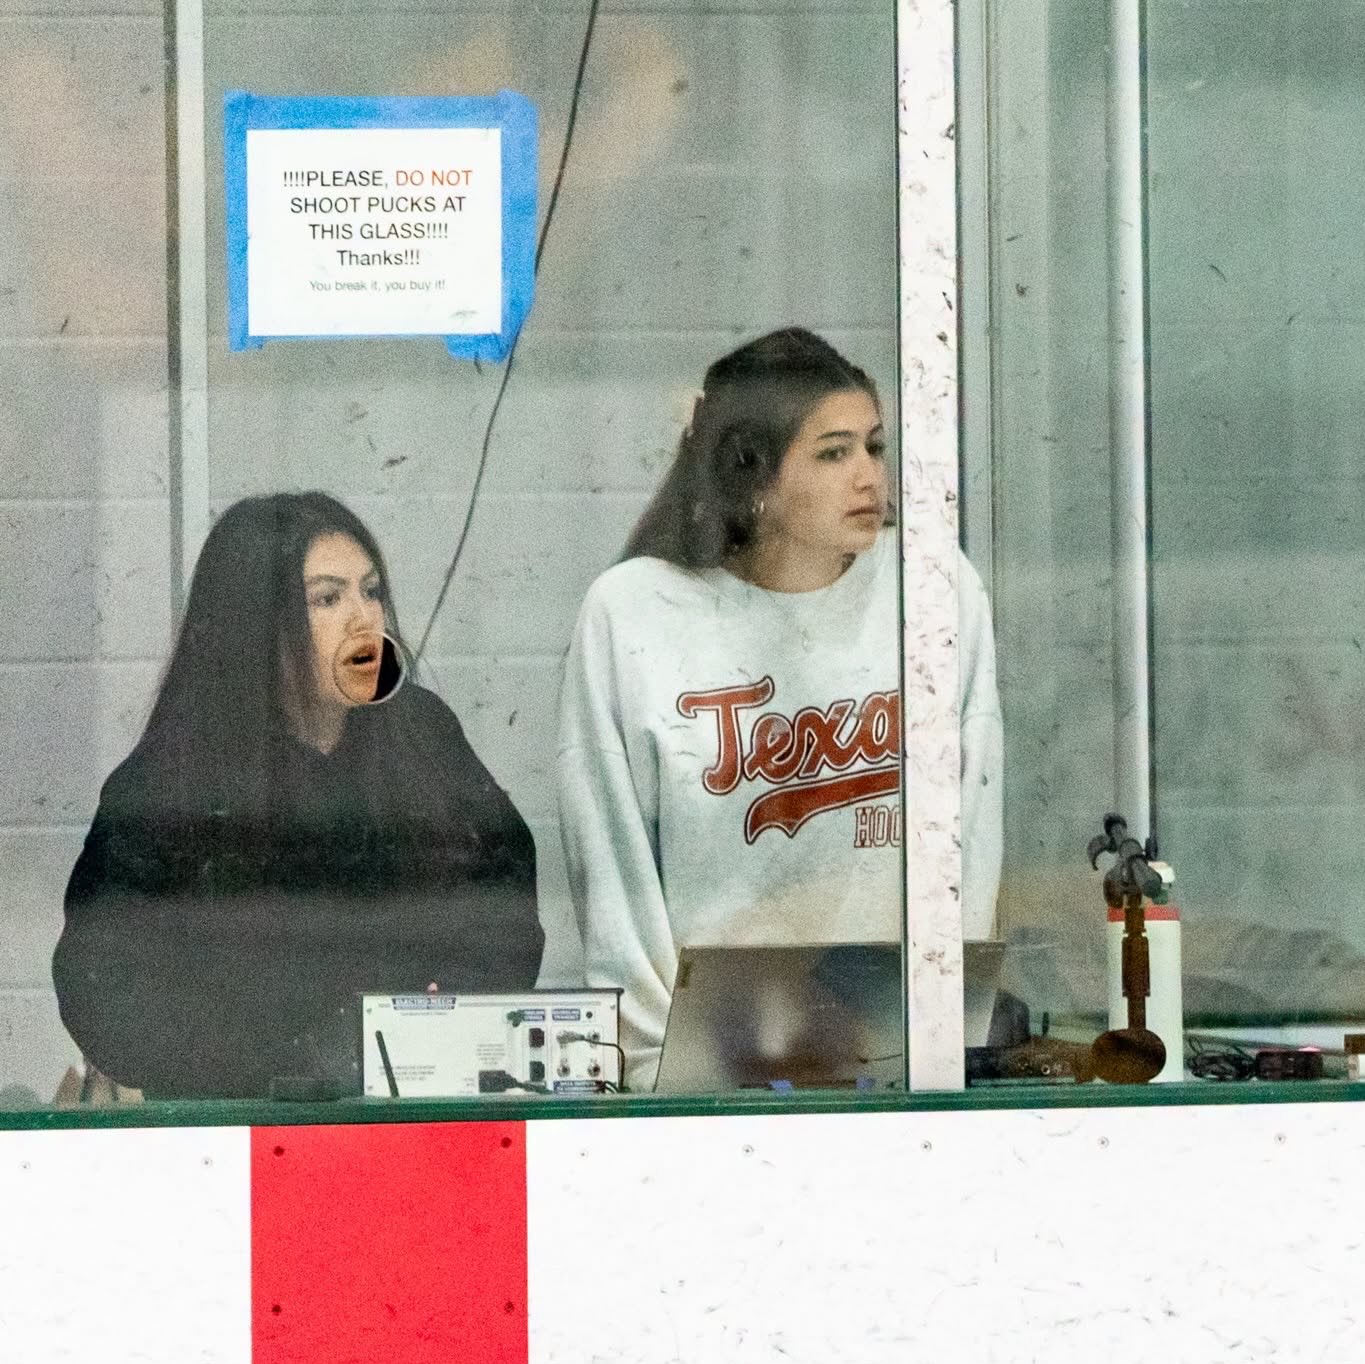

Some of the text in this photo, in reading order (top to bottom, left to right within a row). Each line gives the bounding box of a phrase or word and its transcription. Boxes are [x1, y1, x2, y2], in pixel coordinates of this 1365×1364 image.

[283, 170, 473, 188] !!!!PLEASE, DO NOT
[290, 196, 467, 213] SHOOT PUCKS AT
[308, 222, 448, 239] THIS GLASS!!!!
[336, 249, 420, 266] Thanks!!!
[309, 280, 331, 291] You
[335, 280, 368, 291] break
[384, 281, 406, 292] you
[409, 280, 431, 291] buy
[676, 675, 900, 796] Texa
